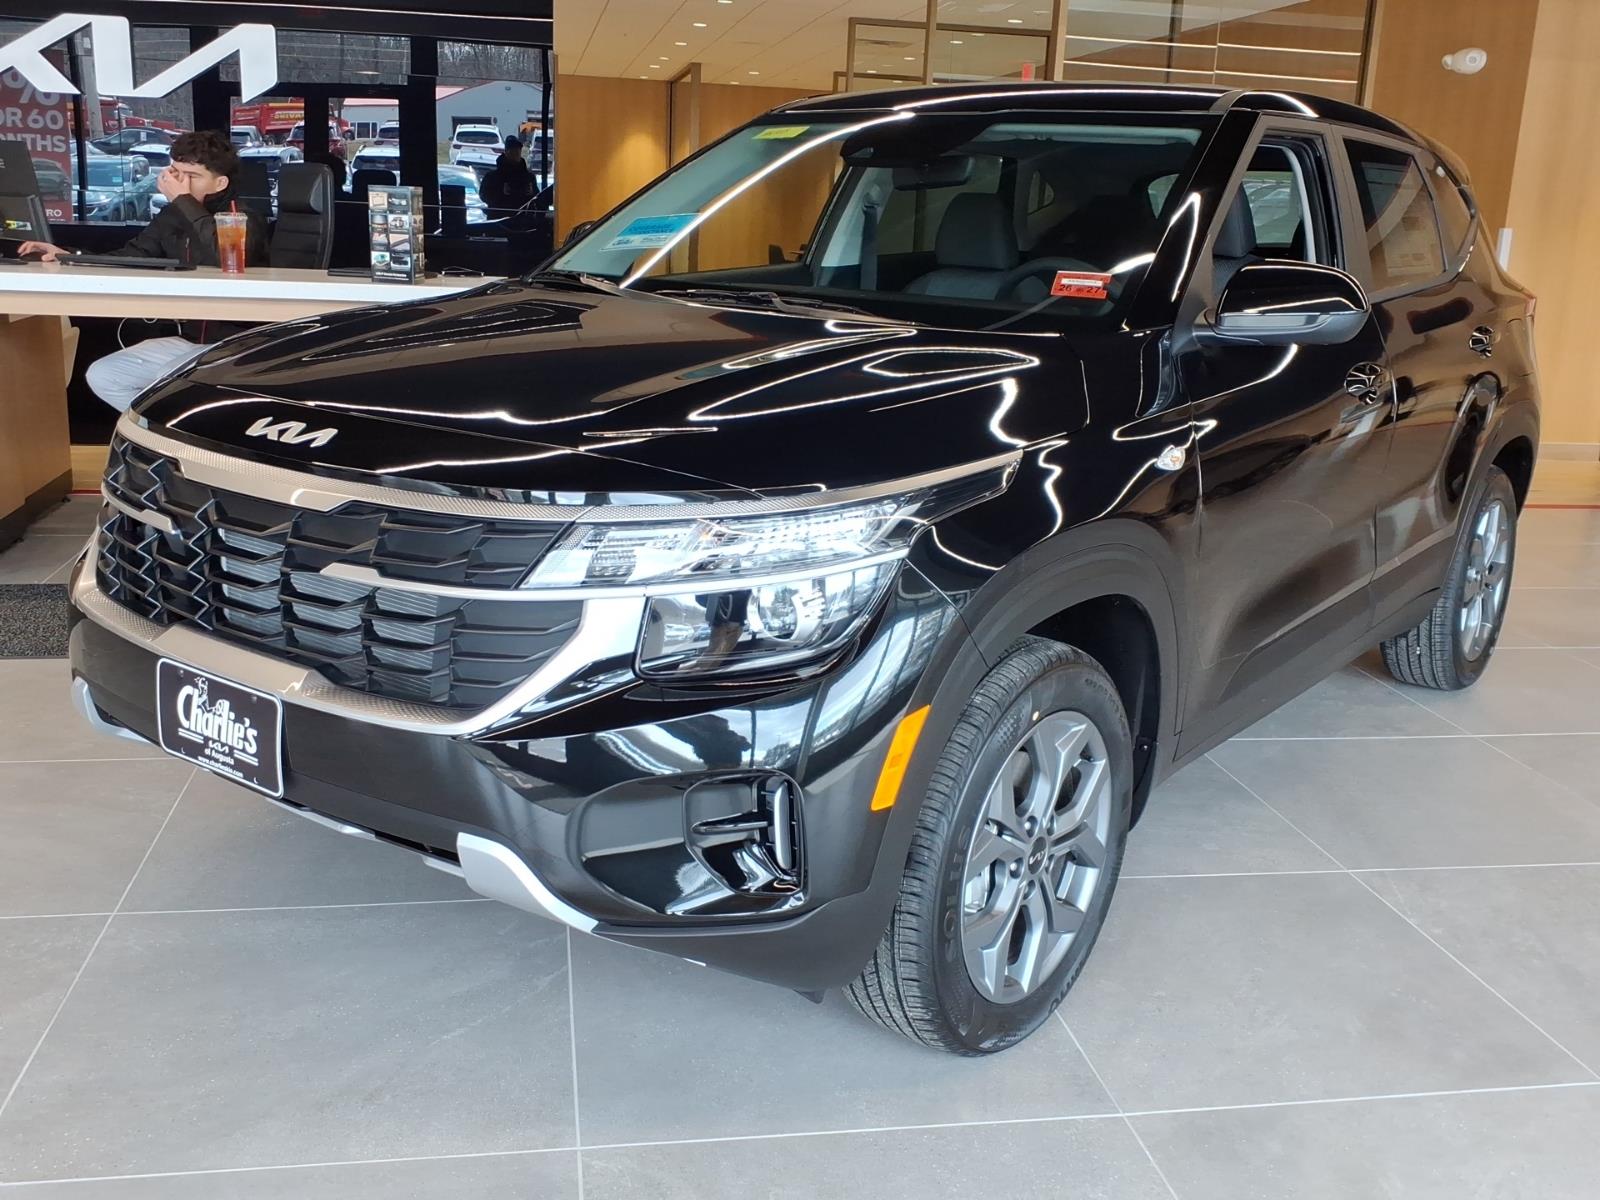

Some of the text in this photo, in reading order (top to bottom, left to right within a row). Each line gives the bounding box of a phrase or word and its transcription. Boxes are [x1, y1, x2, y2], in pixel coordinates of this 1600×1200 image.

[0, 107, 64, 130] R 60
[0, 133, 67, 152] THS
[245, 416, 339, 447] KIA
[177, 684, 258, 755] Charlie's
